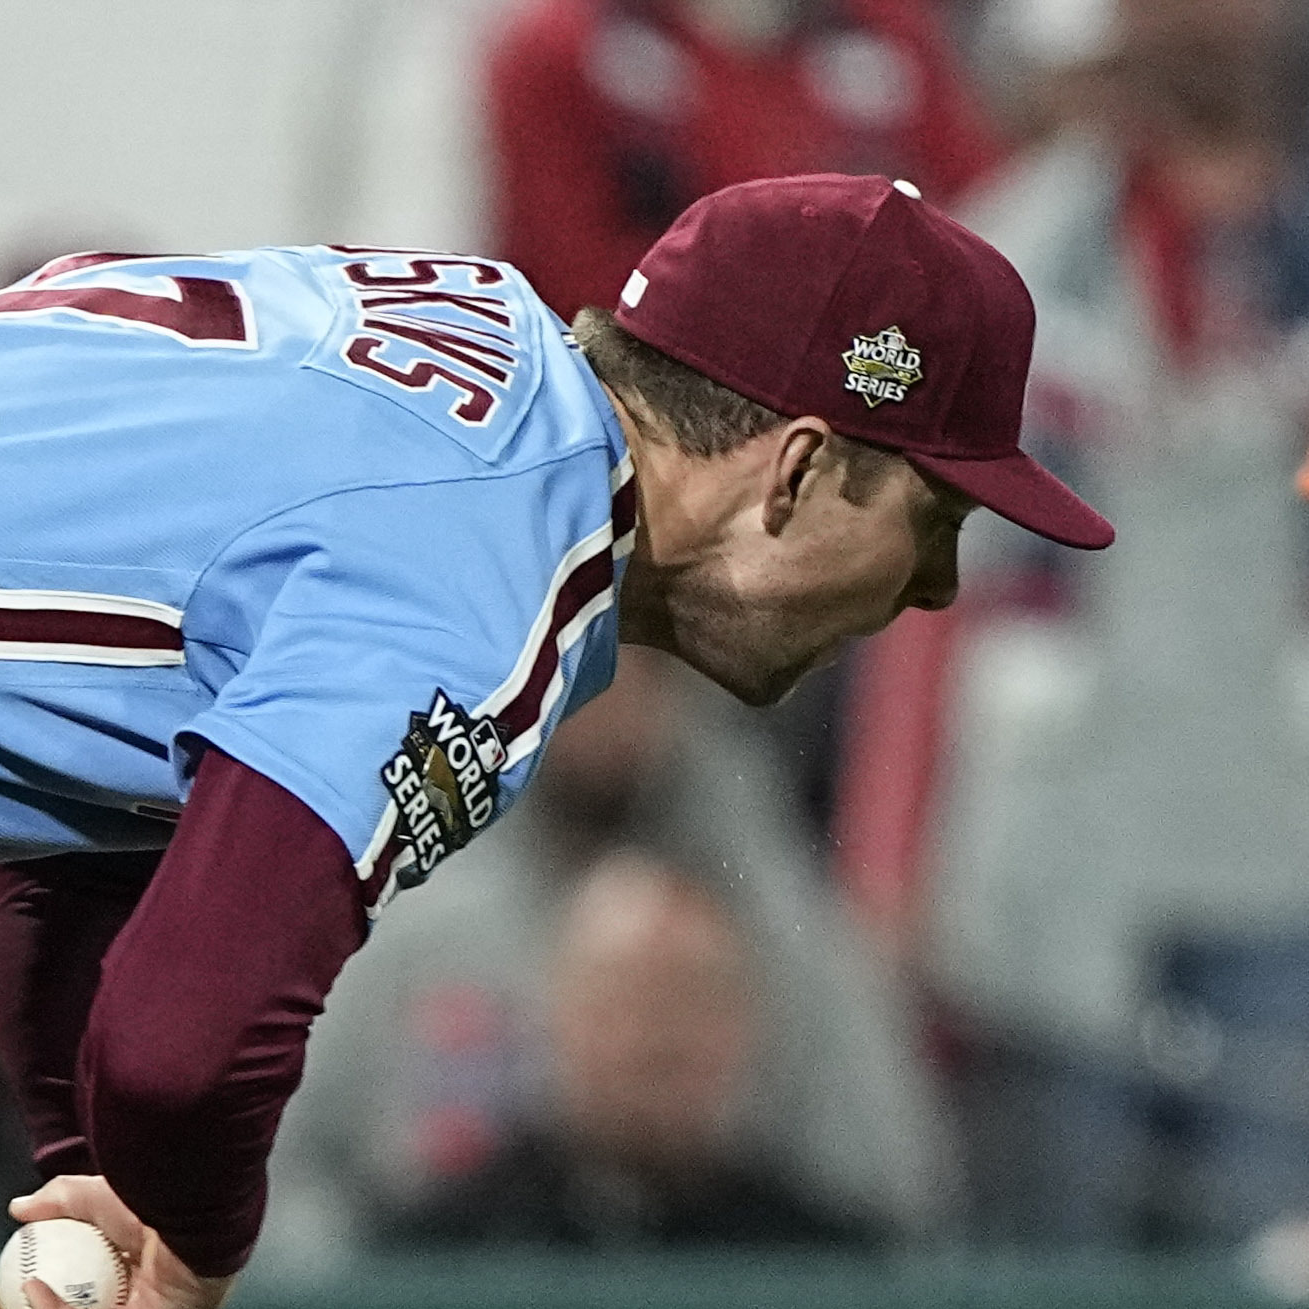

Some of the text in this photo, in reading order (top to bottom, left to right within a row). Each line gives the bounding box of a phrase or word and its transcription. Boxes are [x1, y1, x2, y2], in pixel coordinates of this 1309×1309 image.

[844, 372, 908, 402] SERIES
[853, 337, 921, 370] WORLD
[428, 694, 493, 829] WORLD
[384, 754, 446, 872] SERIES
